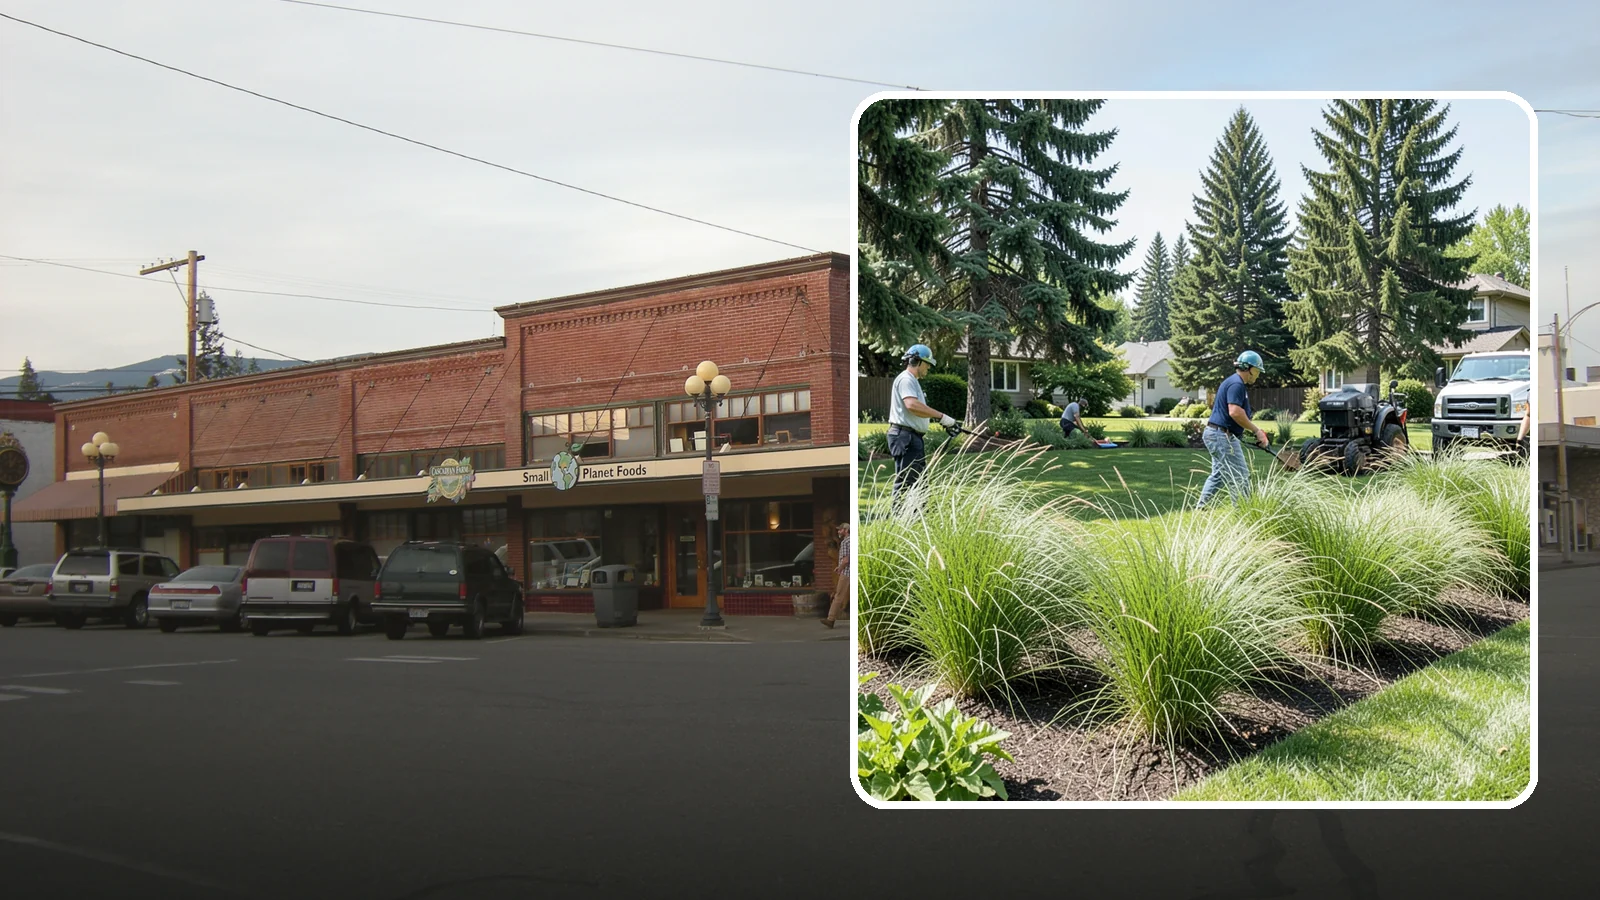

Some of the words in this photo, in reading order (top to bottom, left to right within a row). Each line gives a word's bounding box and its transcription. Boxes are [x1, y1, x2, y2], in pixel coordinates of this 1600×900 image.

[523, 470, 549, 483] Small
[583, 467, 614, 479] Planet
[617, 464, 647, 476] Foods
